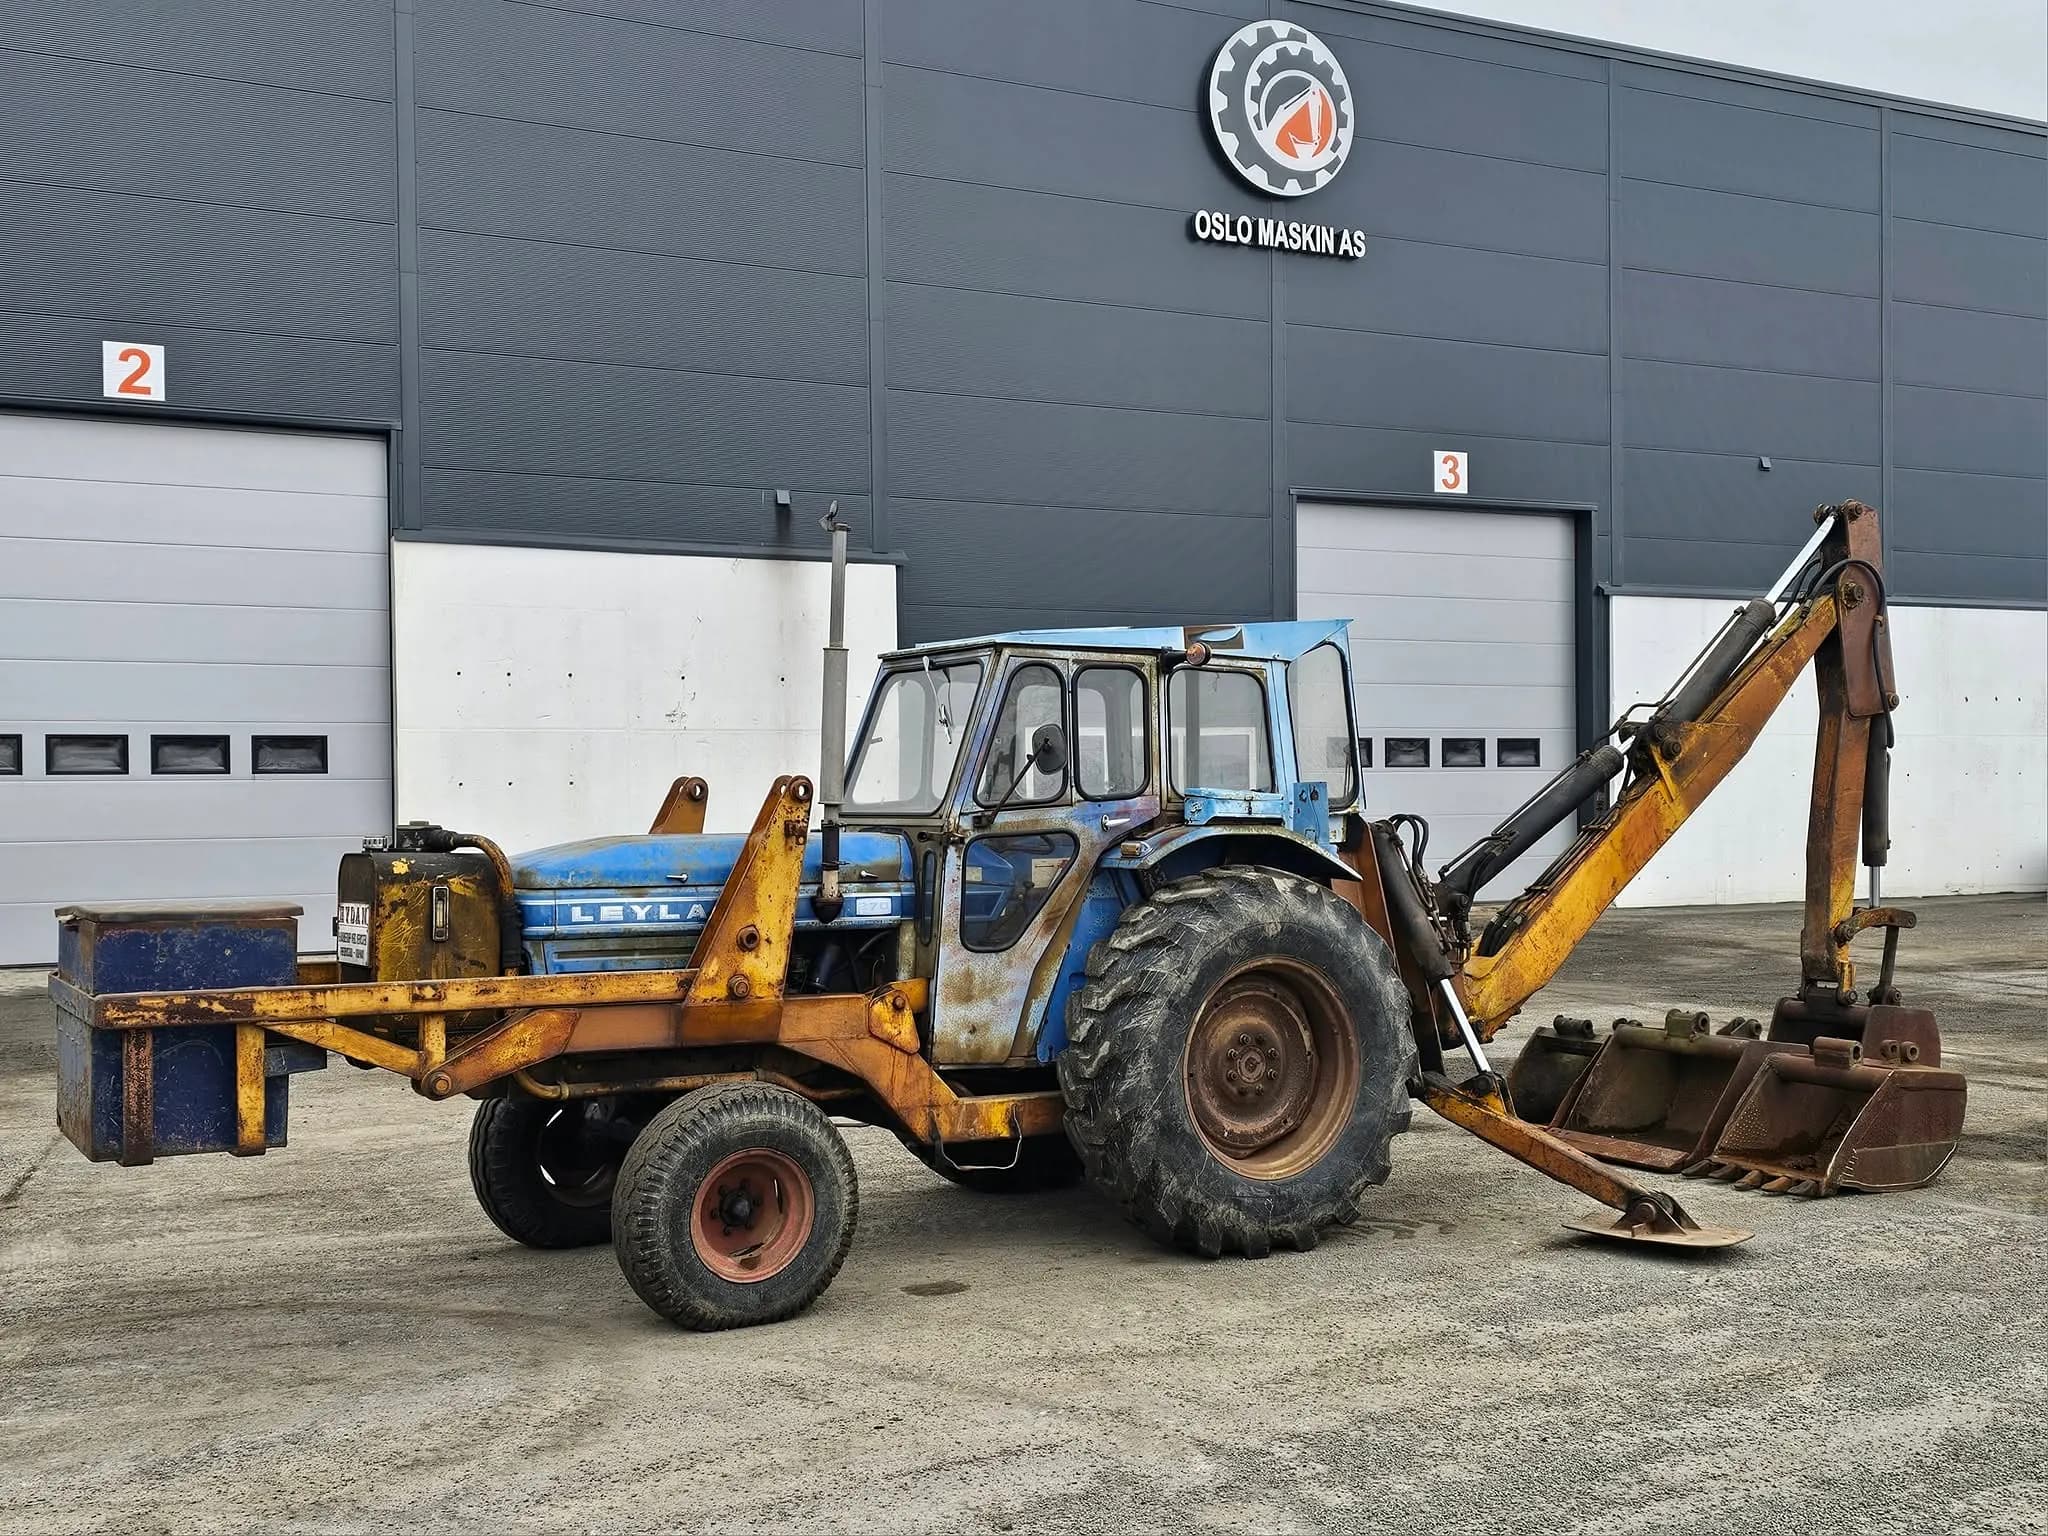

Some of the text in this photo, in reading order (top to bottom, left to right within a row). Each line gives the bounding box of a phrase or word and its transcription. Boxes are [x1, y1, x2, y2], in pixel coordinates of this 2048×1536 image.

[1194, 209, 1367, 258] OSLO MASKIN AS
[118, 347, 152, 395] 2
[1441, 454, 1461, 490] 3
